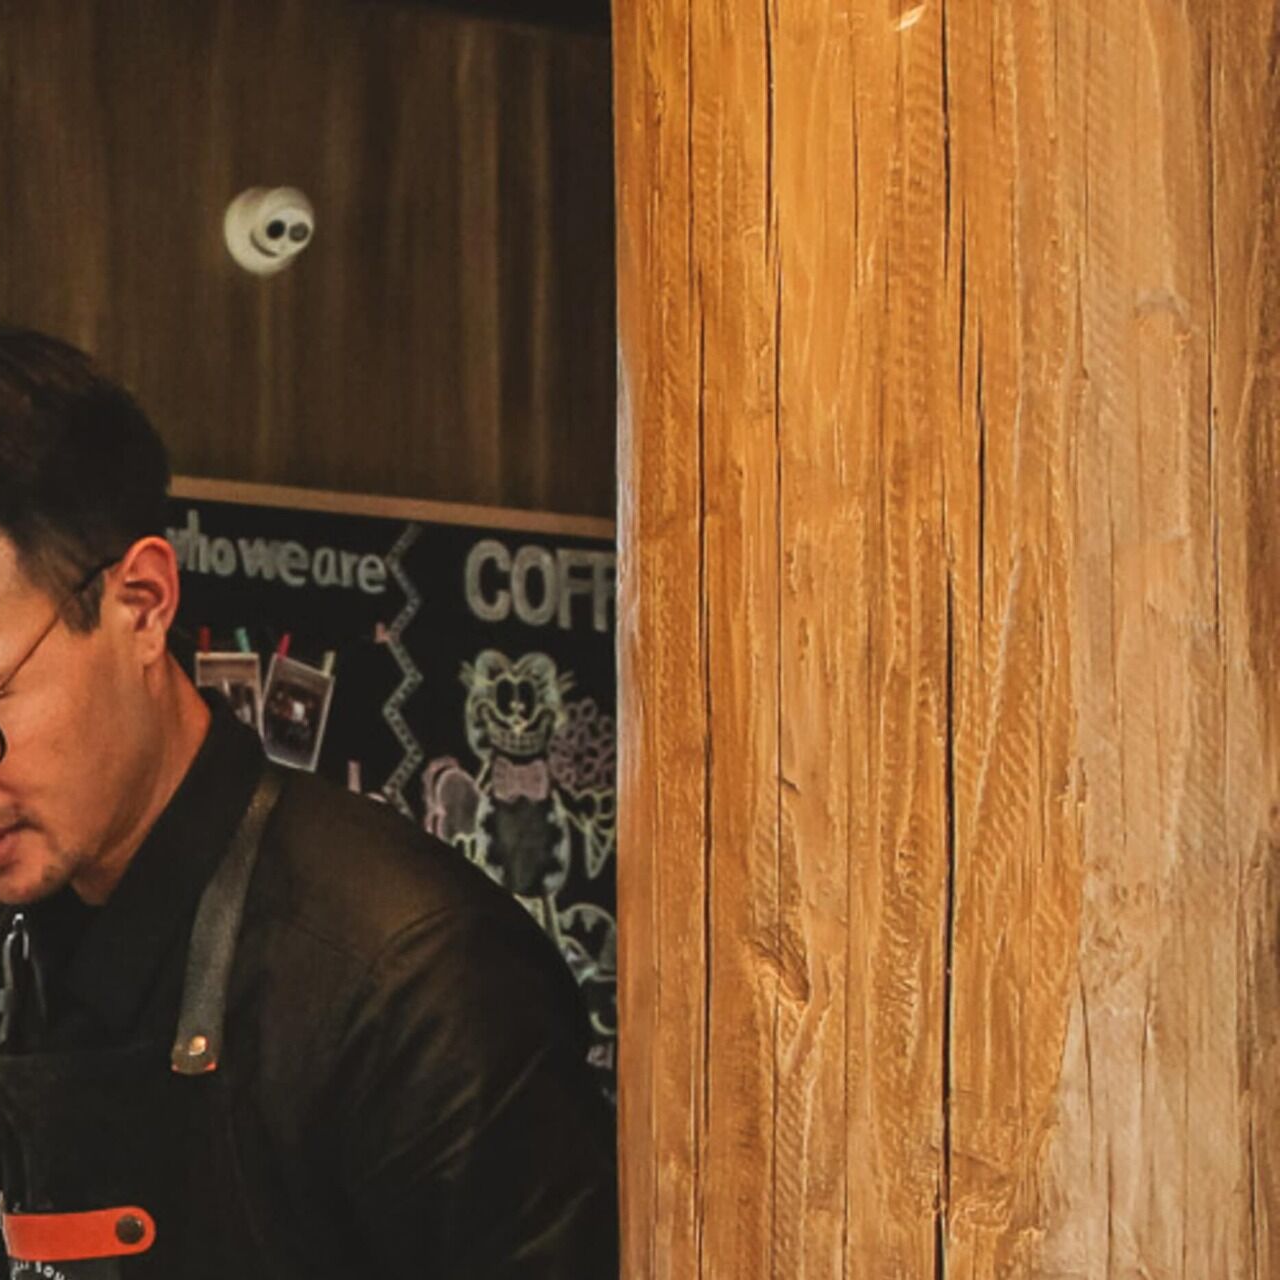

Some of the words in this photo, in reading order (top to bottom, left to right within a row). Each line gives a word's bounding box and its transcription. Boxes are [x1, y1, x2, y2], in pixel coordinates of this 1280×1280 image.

[238, 537, 309, 587] we
[312, 547, 387, 593] are
[465, 539, 617, 632] COFF
